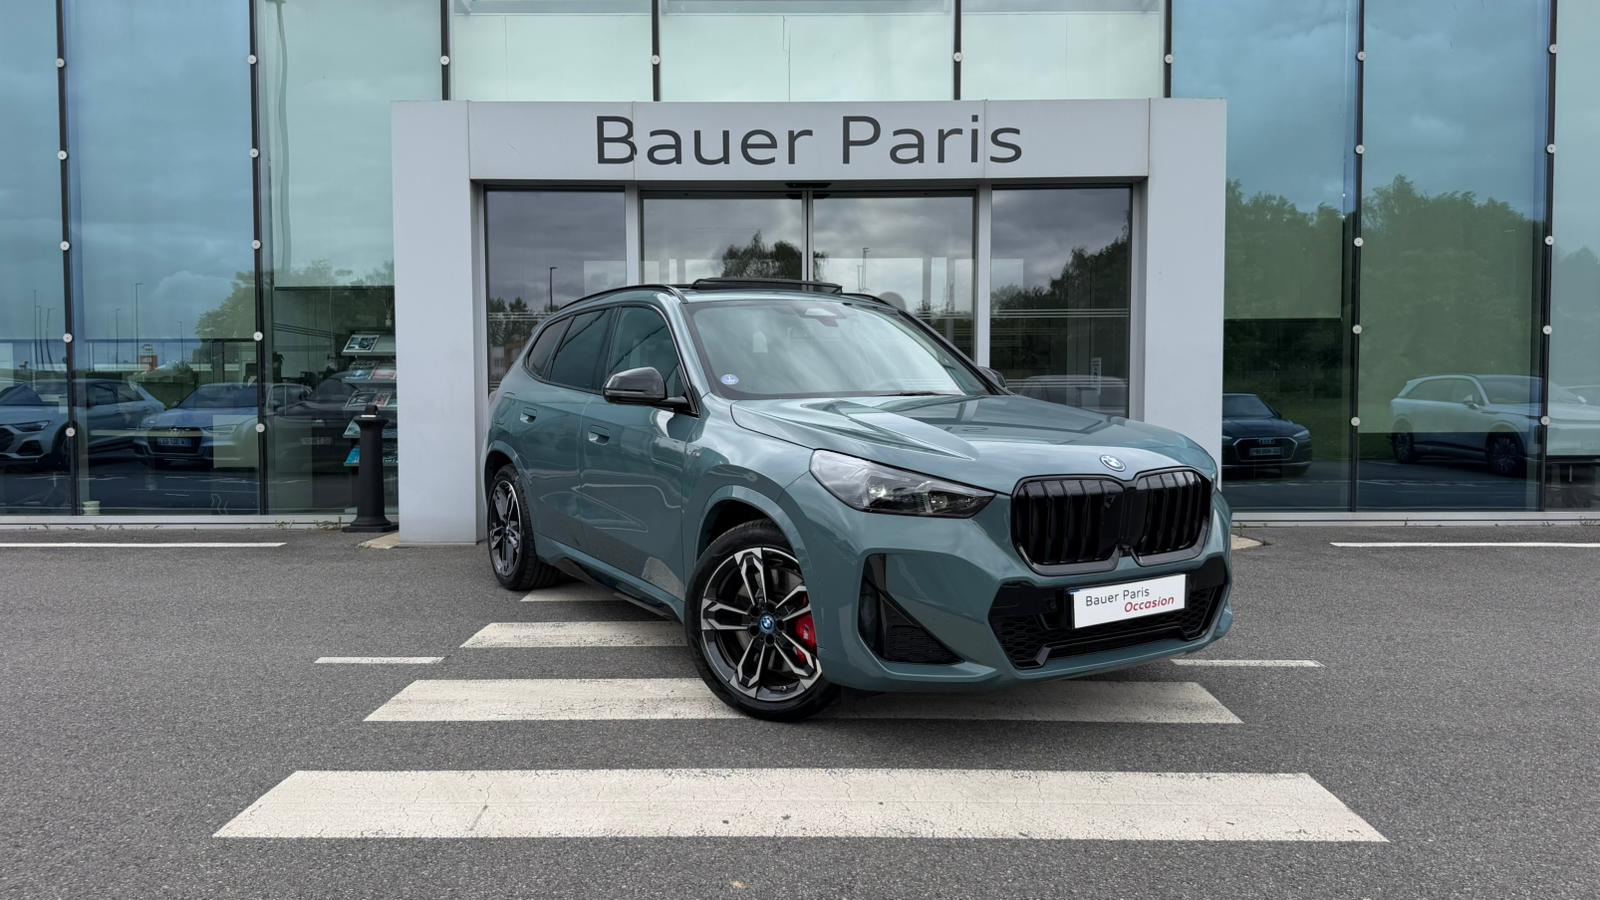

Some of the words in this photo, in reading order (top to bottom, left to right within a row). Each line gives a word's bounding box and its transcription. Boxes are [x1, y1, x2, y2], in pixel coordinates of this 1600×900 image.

[596, 115, 813, 165] Bauer
[842, 114, 1022, 164] Paris
[1085, 593, 1119, 607] Bauer
[1123, 587, 1150, 600] Paris
[1124, 596, 1174, 613] Occasion
